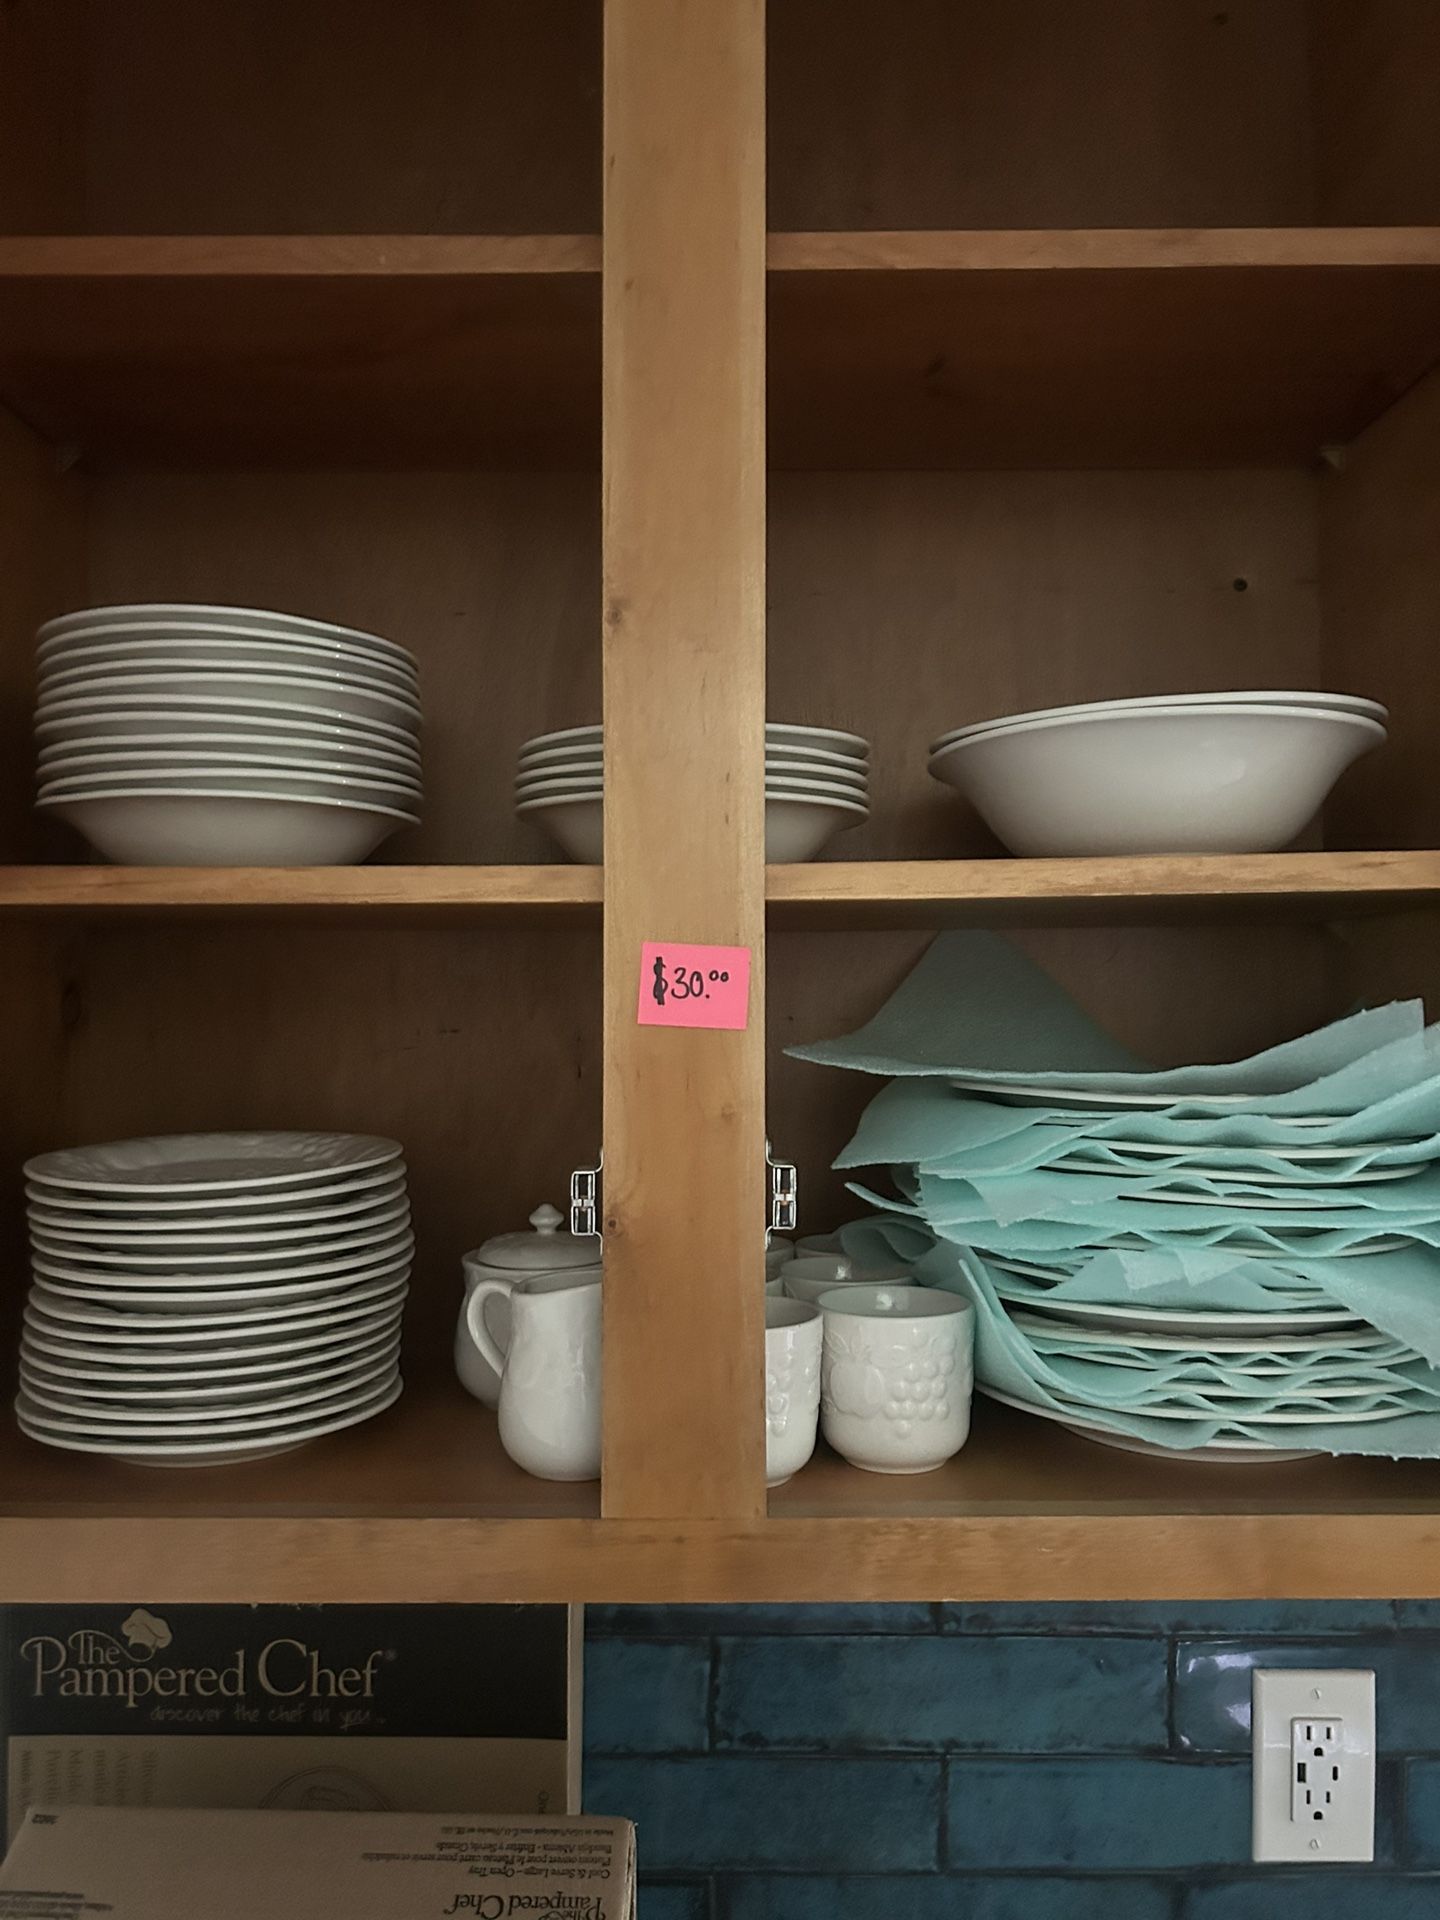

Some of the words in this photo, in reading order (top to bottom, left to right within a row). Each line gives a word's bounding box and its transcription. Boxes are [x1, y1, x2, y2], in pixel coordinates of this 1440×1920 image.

[653, 956, 729, 1005] $30.00
[68, 1630, 121, 1665] The
[20, 1636, 247, 1708] Pampered
[150, 1704, 224, 1722] discover
[234, 1703, 260, 1723] the
[268, 1702, 305, 1722] chef
[312, 1707, 331, 1723] in
[508, 1891, 607, 1920] Pampered
